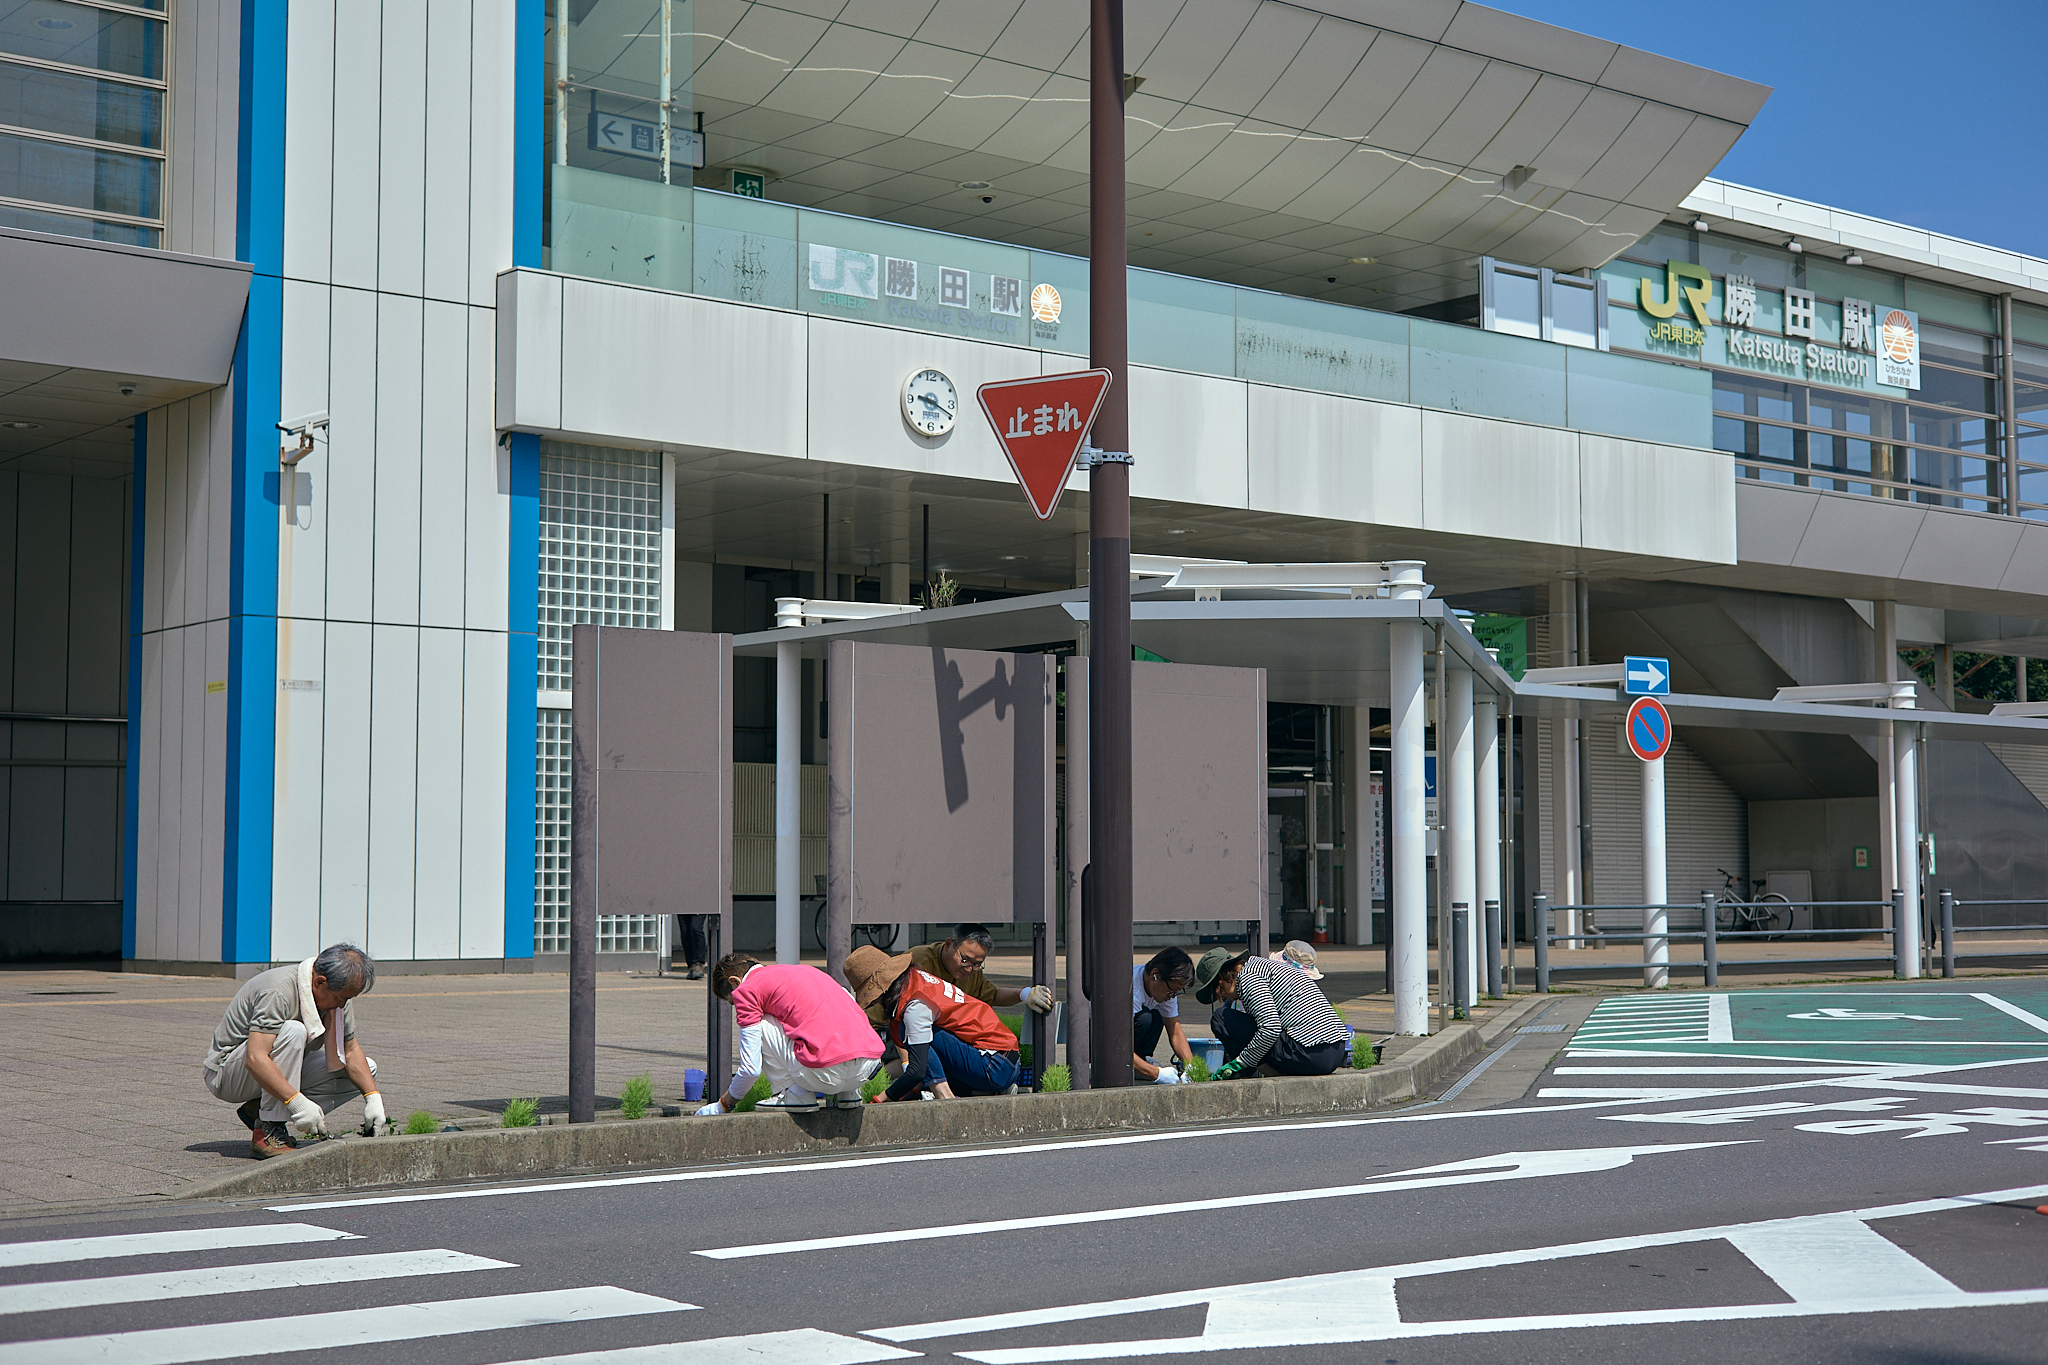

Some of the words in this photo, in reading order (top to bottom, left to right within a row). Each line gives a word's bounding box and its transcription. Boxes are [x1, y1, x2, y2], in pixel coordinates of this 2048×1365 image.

[811, 248, 875, 297] JR
[886, 259, 1019, 314] 勝田駅
[819, 292, 867, 310] JR東日本
[1641, 259, 1712, 327] JR
[1723, 272, 1873, 350] 勝田駅
[889, 298, 953, 324] Katsuta
[958, 309, 1016, 334] Station
[1650, 321, 1705, 346] JR東日本
[1729, 328, 1801, 366] Katsuta
[1805, 343, 1869, 378] Station
[925, 371, 937, 382] 12
[907, 393, 914, 404] 9
[947, 399, 955, 410] 3
[927, 421, 935, 432] 6
[1005, 401, 1083, 439] 止まれ
